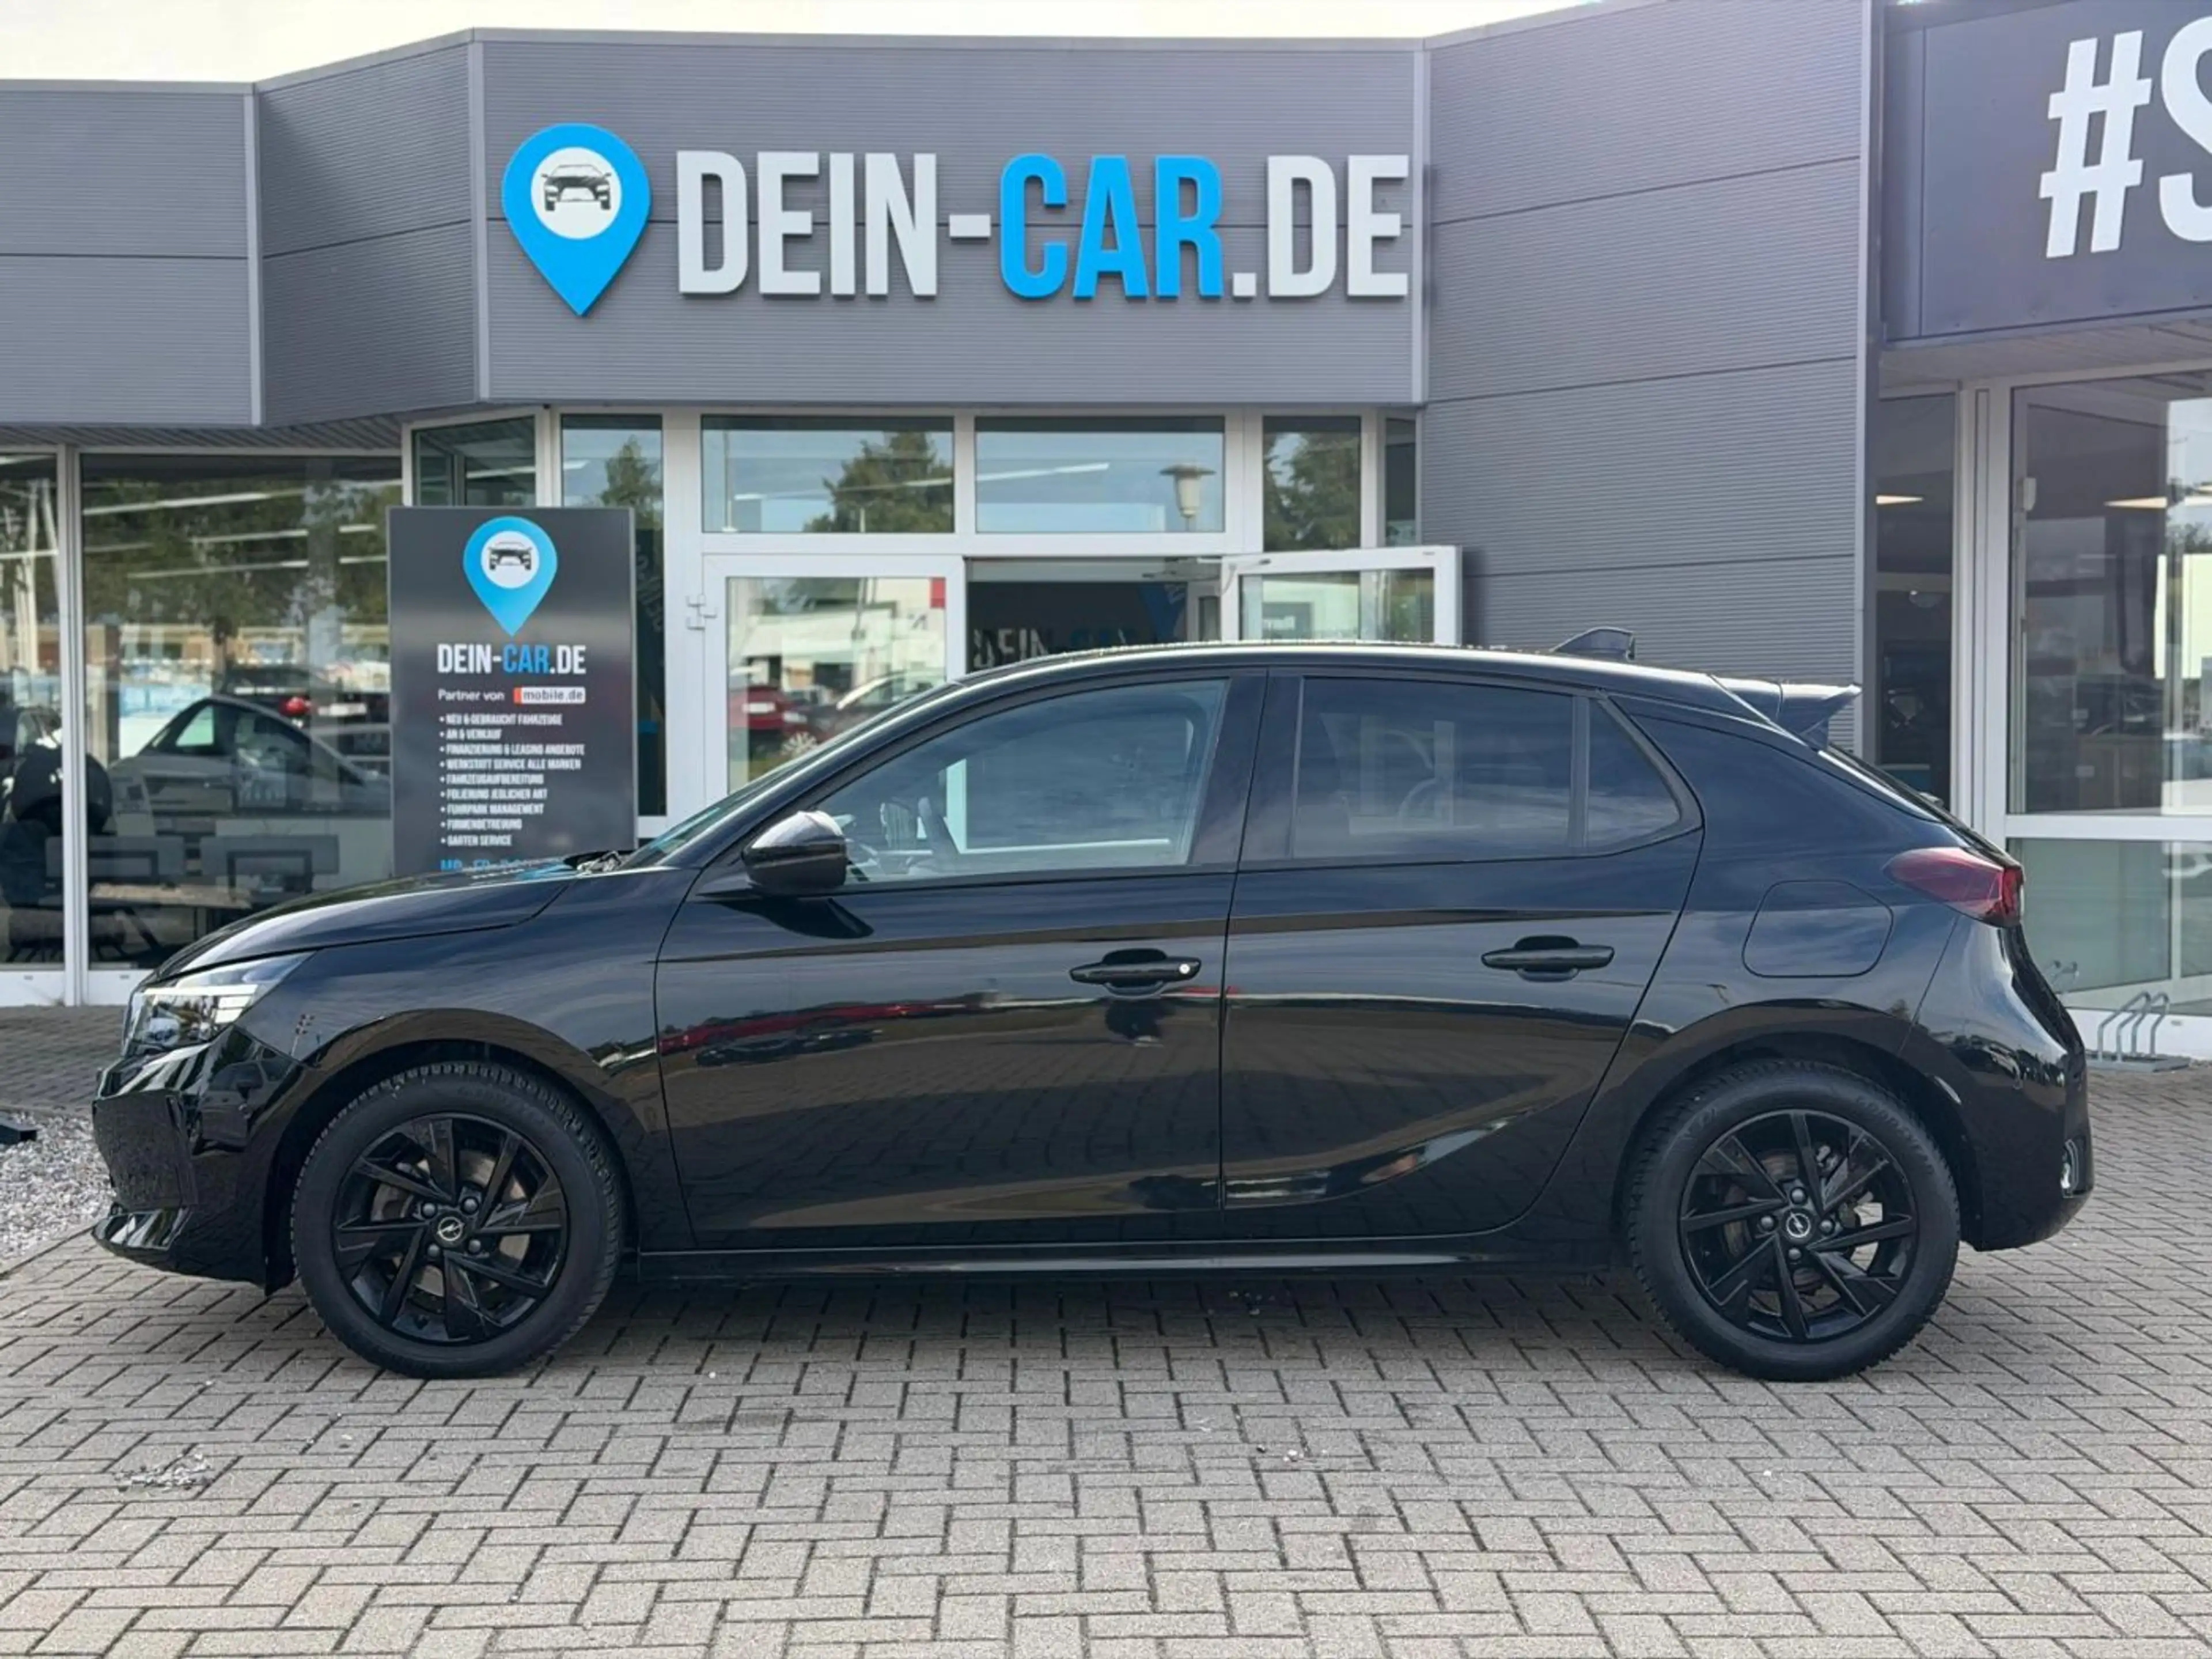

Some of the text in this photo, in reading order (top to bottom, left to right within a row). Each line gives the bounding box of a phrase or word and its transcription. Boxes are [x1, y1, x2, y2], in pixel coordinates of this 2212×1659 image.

[677, 150, 1409, 298] DEIN-CAR.DE
[437, 643, 586, 674] DEIN-CAR.DE
[438, 688, 583, 701] Partner von mobile.de
[466, 729, 502, 740] VERKAUF
[480, 835, 513, 847] SERVICE
